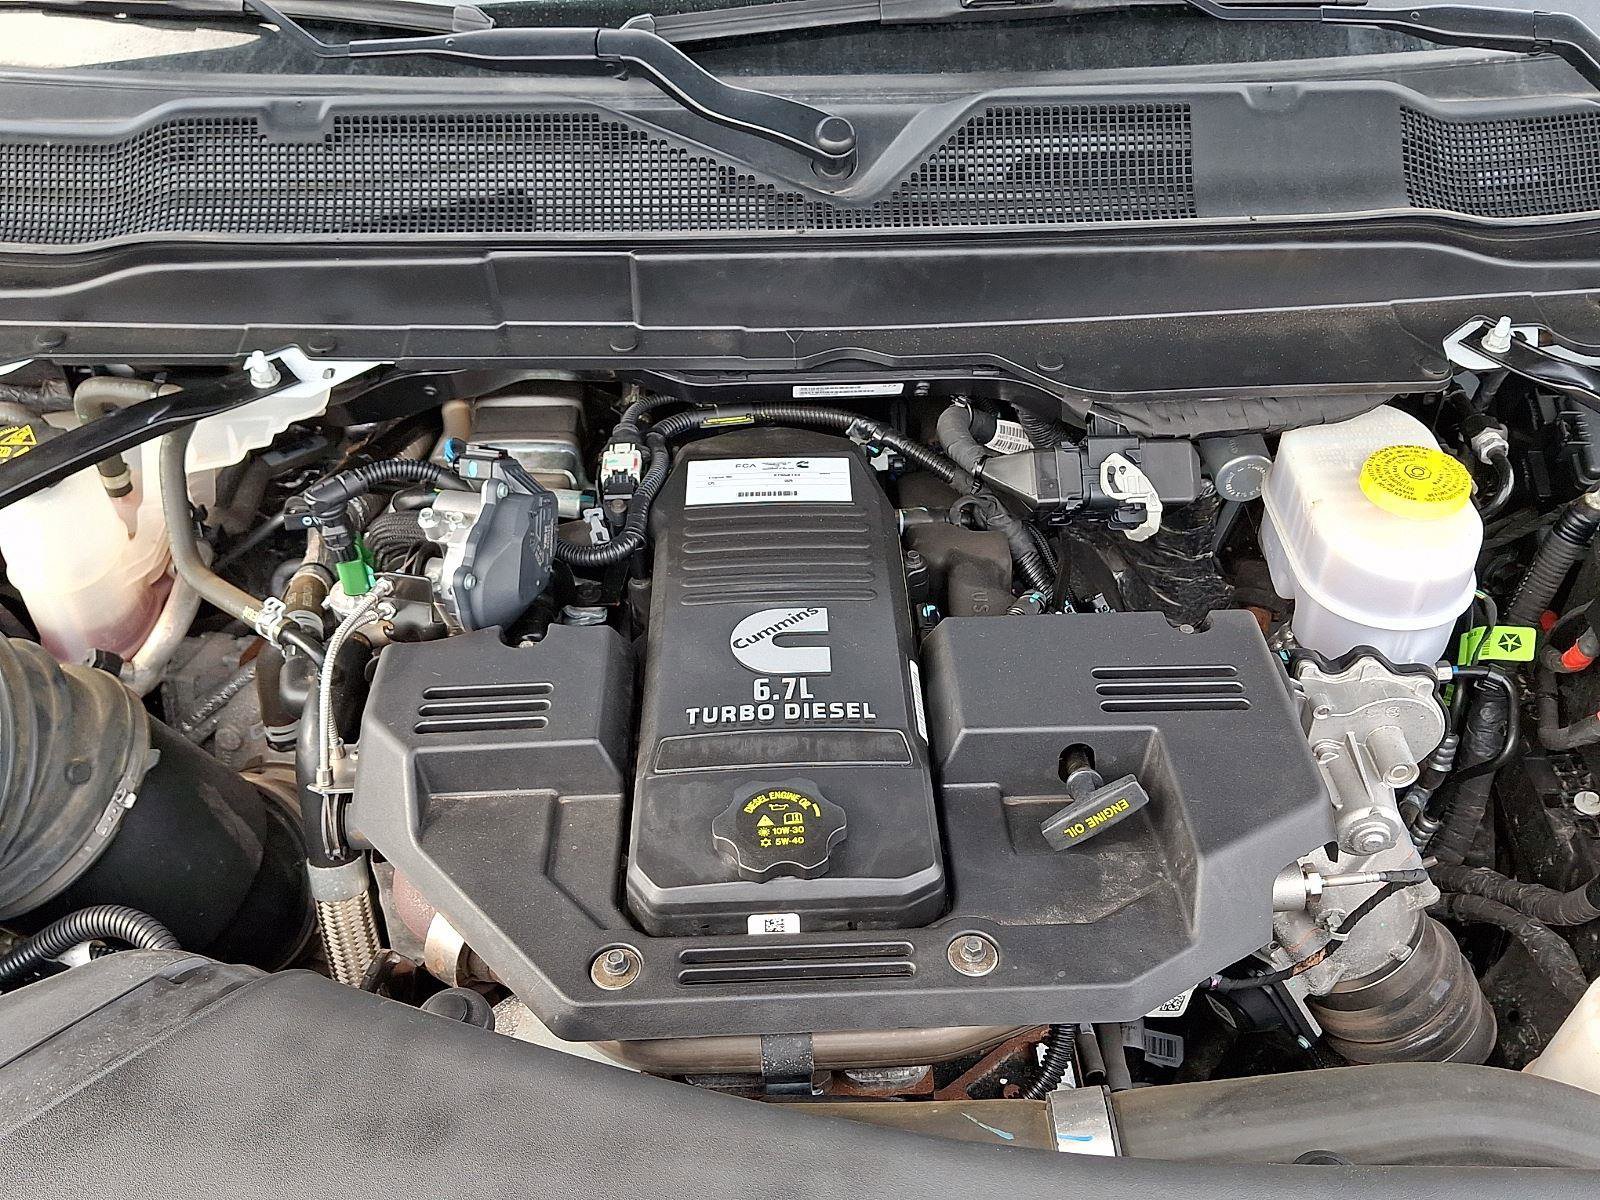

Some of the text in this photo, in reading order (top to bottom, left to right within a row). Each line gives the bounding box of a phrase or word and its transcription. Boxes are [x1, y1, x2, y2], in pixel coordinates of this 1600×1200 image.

[732, 607, 819, 649] Cummins
[753, 677, 815, 701] 6.7L
[686, 702, 877, 725] TURBO DIESEL
[743, 790, 812, 814] DIESEL ENGINE OIL
[1063, 798, 1130, 838] ENGINE OIL
[772, 826, 805, 836] 10W-30
[775, 836, 805, 846] 5W-40
